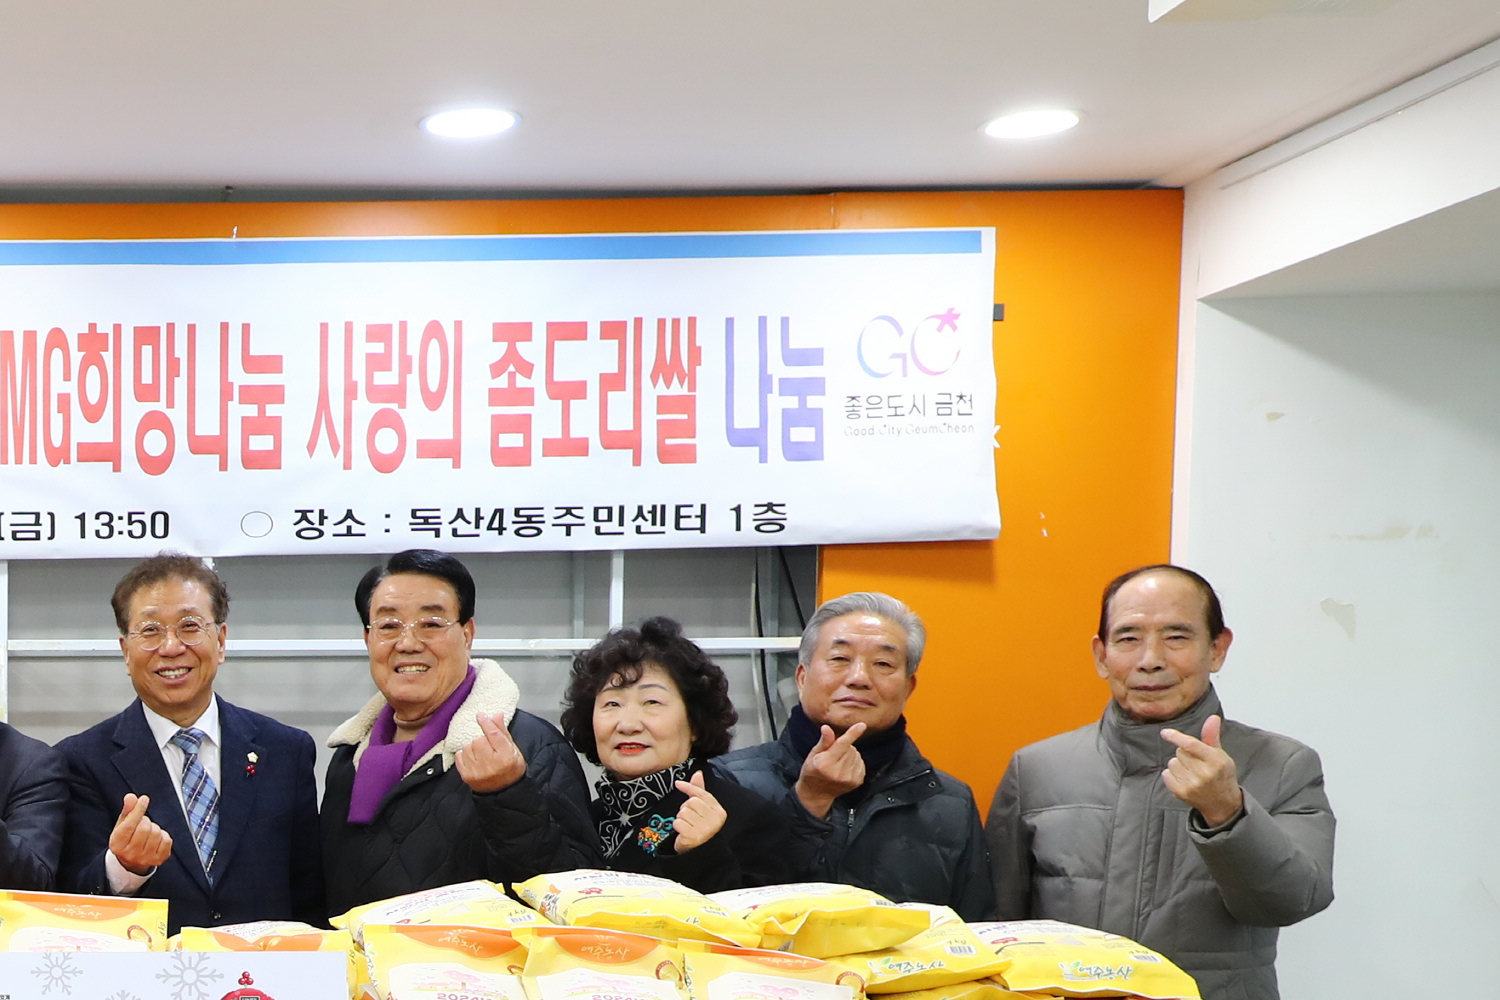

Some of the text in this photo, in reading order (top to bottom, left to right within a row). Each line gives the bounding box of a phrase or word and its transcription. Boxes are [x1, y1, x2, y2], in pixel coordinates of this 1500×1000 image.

[0, 321, 285, 477] MG희망나눔
[306, 319, 463, 474] 사랑의
[488, 316, 702, 468] 좀도리쌀
[724, 315, 826, 464] 나눔
[845, 392, 973, 420] 좋은도시 금천
[74, 510, 170, 540] 13:50
[292, 508, 367, 541] 장소
[408, 503, 707, 539] 독산4동주민센터
[729, 501, 788, 534] 1층
